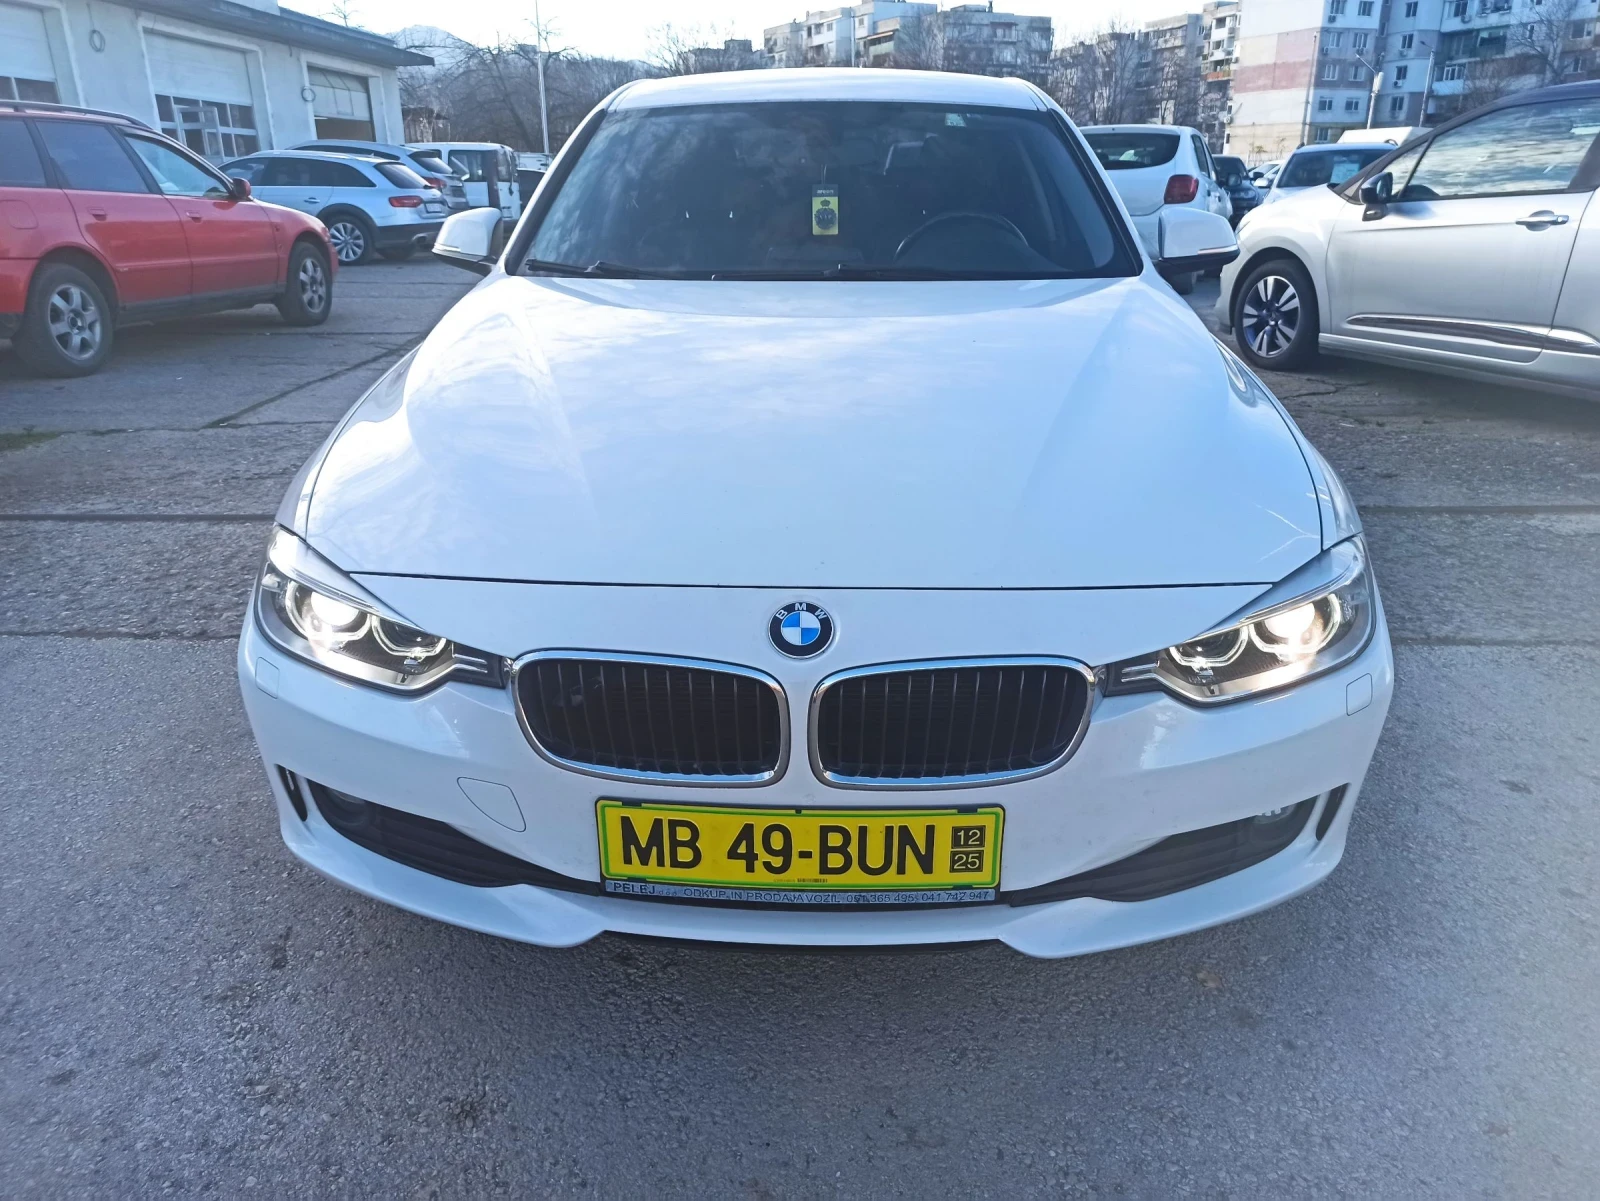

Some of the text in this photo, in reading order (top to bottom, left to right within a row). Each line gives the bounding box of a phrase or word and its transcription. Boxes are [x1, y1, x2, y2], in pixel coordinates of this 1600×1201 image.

[775, 602, 828, 620] BMW
[620, 815, 936, 876] MB 49-BUN
[957, 829, 981, 845] 12
[953, 853, 980, 869] 25
[613, 882, 656, 894] PELEJ
[731, 891, 742, 899] IN
[969, 891, 989, 900] 947
